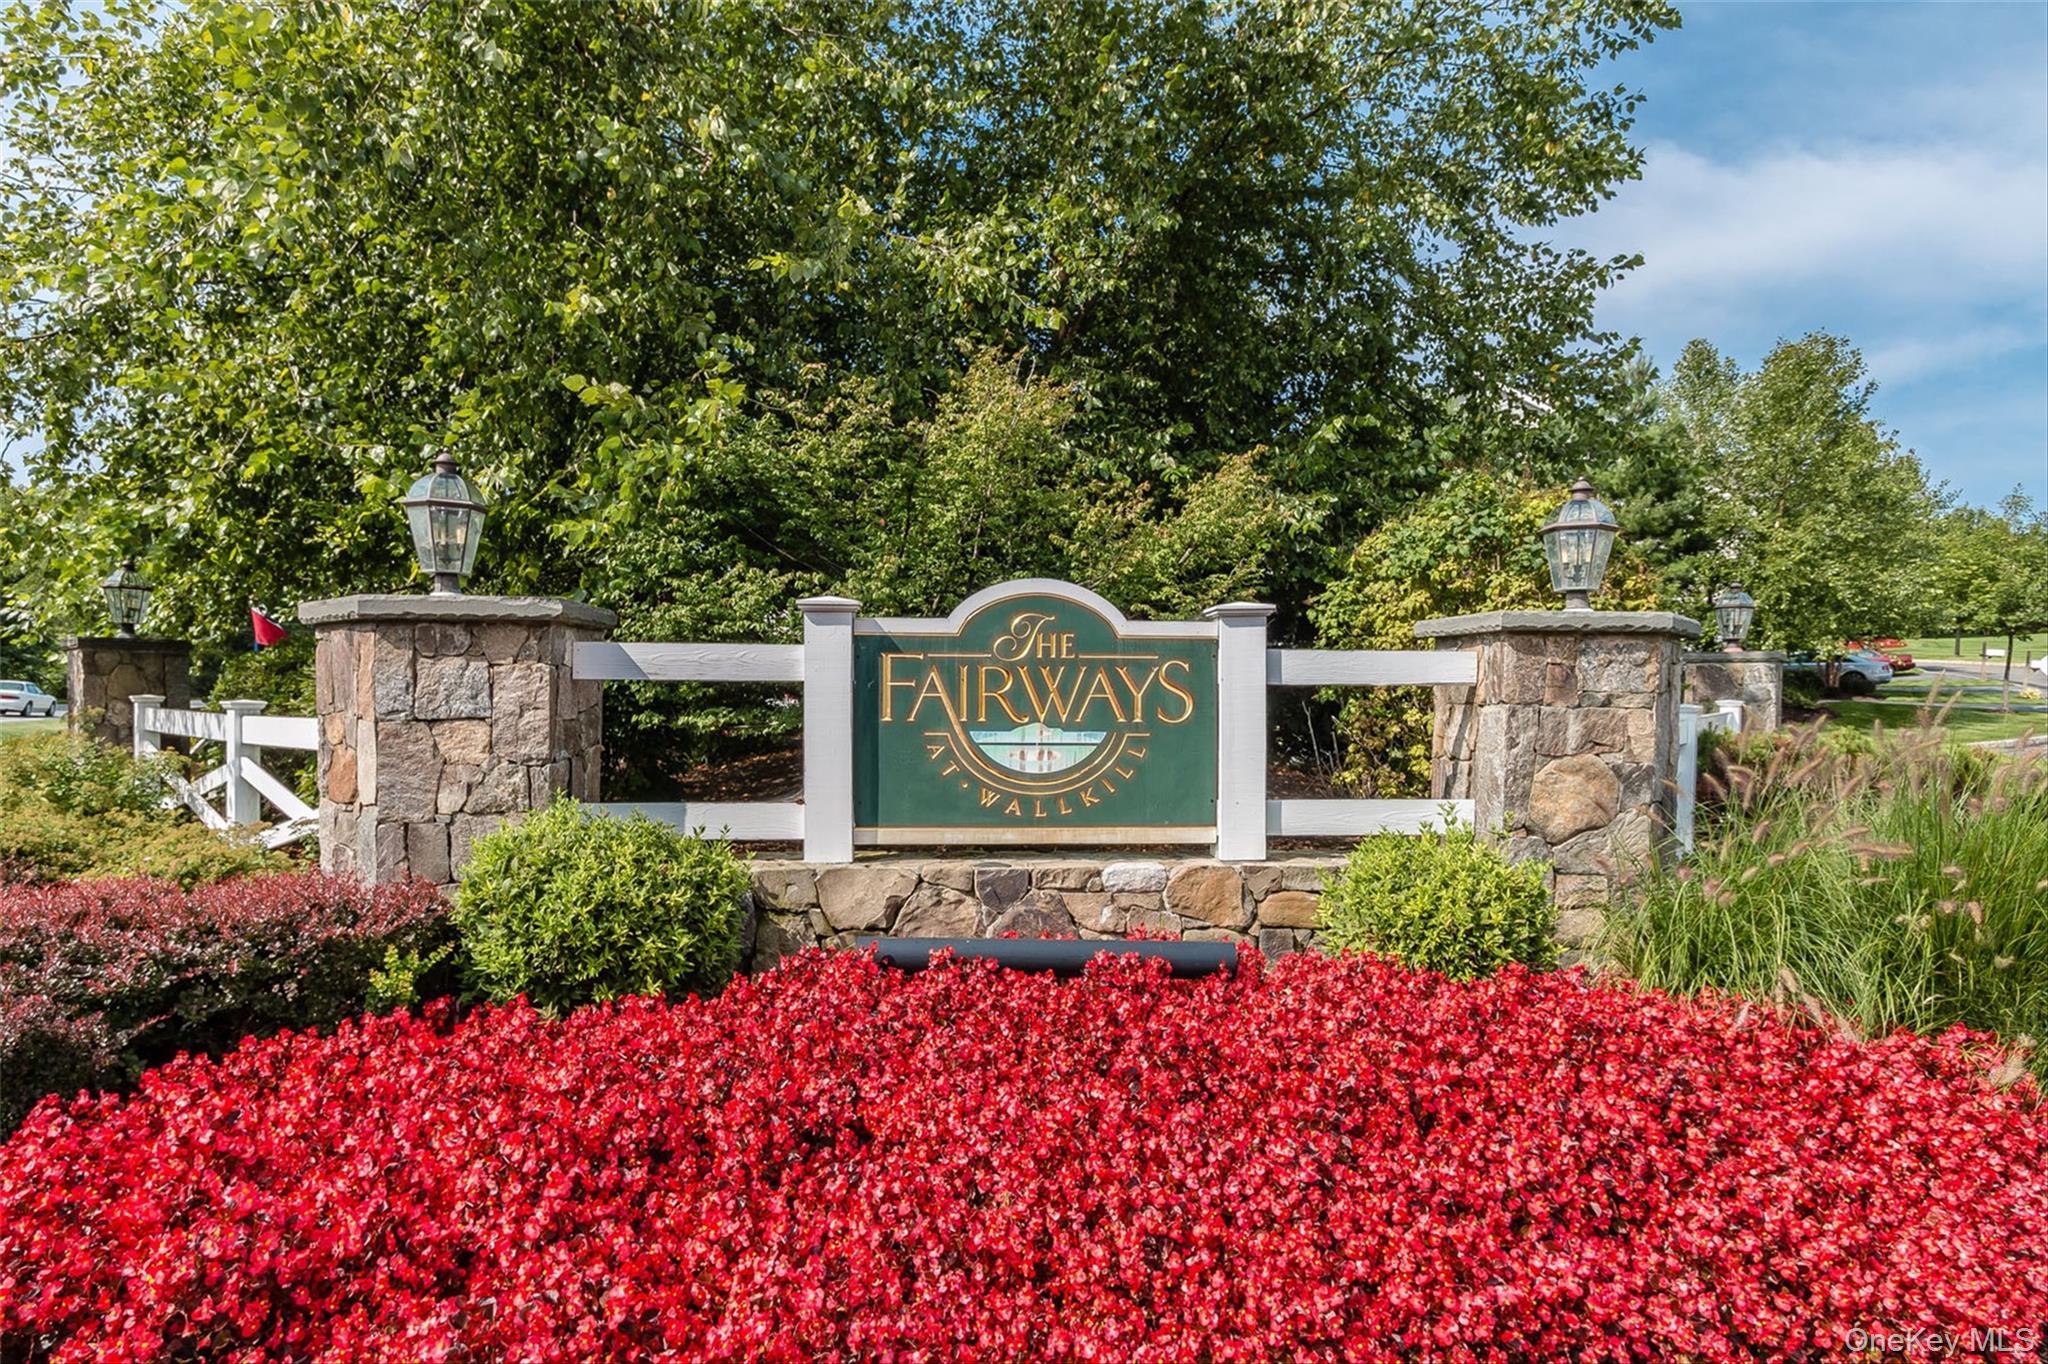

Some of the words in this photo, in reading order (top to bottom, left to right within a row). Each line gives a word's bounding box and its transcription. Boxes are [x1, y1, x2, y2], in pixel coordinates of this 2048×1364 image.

[993, 612, 1076, 662] THE
[880, 652, 1195, 725] FAIRWAYS
[926, 743, 962, 777] AT
[978, 746, 1147, 818] WALLKILL
